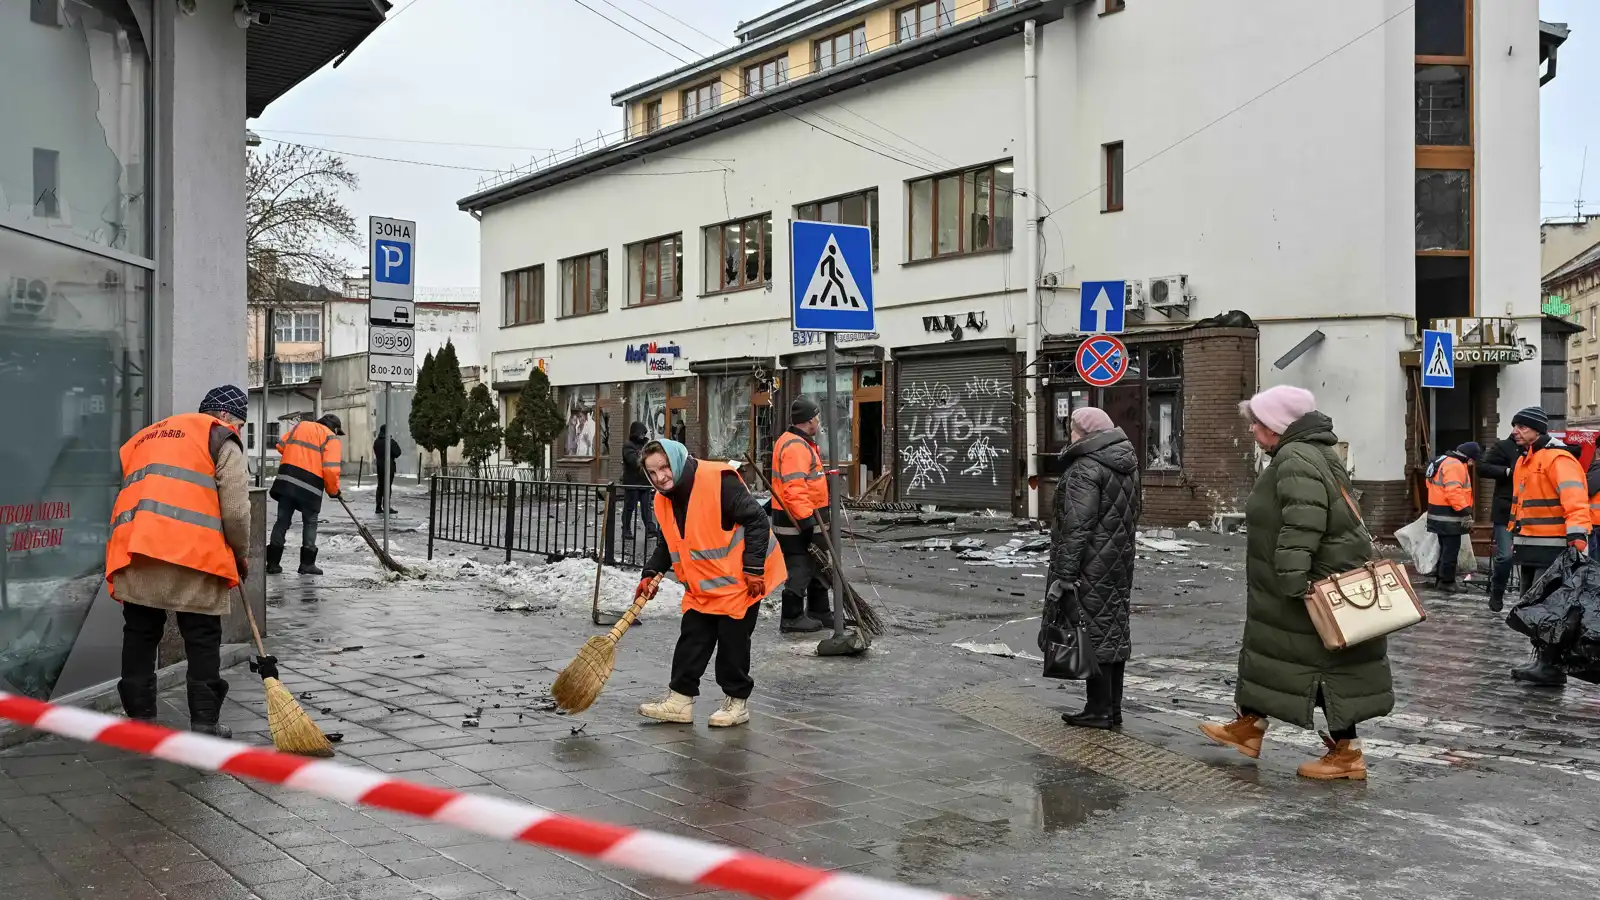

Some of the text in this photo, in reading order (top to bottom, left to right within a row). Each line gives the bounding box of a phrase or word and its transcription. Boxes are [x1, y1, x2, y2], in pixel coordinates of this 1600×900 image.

[375, 221, 411, 239] ЗОНА
[374, 336, 410, 347] 10 25 50
[370, 363, 413, 376] 8.00-20.00
[36, 501, 71, 521] МОВА
[6, 527, 65, 552] ЛЮБОВІ
